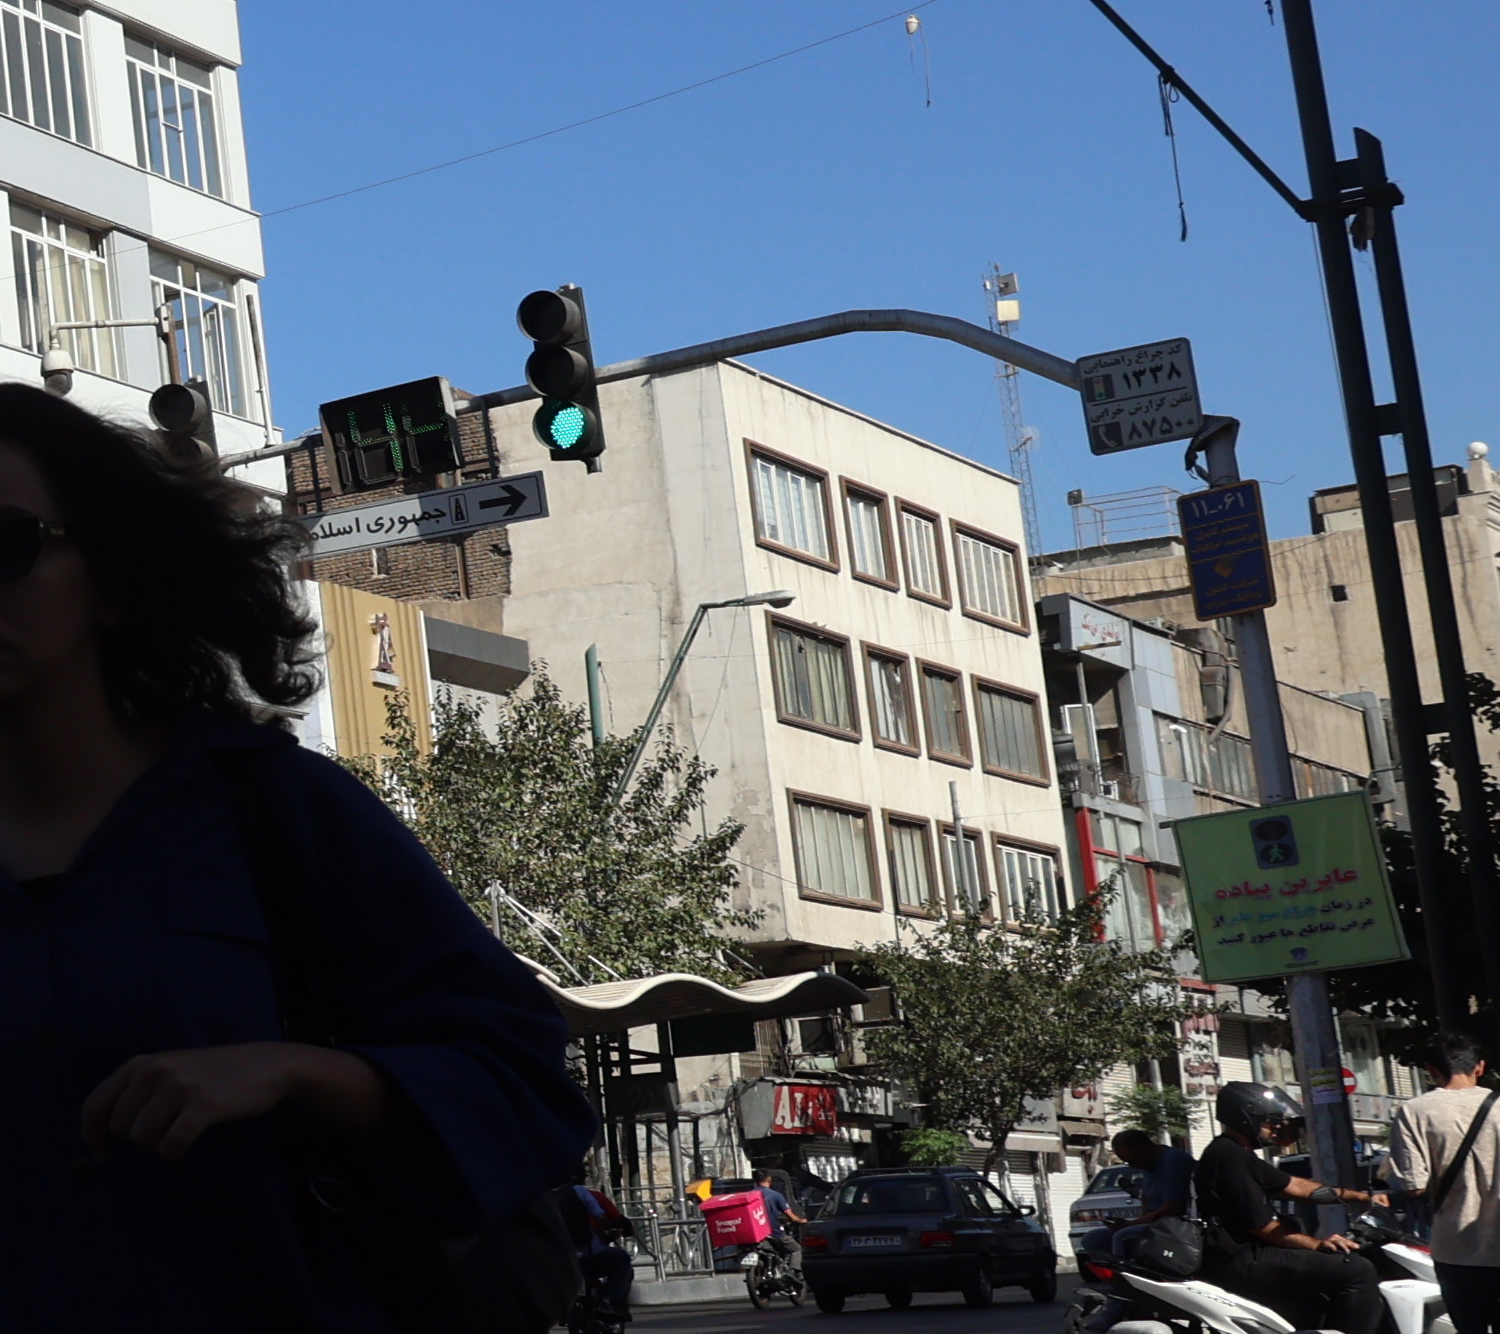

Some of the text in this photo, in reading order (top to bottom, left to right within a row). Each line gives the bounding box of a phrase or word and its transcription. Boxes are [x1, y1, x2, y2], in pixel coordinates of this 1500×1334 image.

[1122, 361, 1182, 389] ۱۳۳۸
[1128, 415, 1195, 441] ۸۷۵۰۰
[310, 505, 448, 543] جمهوری اسلام
[1214, 867, 1357, 900] عابرین پیاده
[1318, 899, 1351, 915] زمان
[1355, 896, 1371, 910] در
[1249, 932, 1276, 945] عبور
[1279, 927, 1293, 939] ها
[716, 1225, 737, 1234] Food
